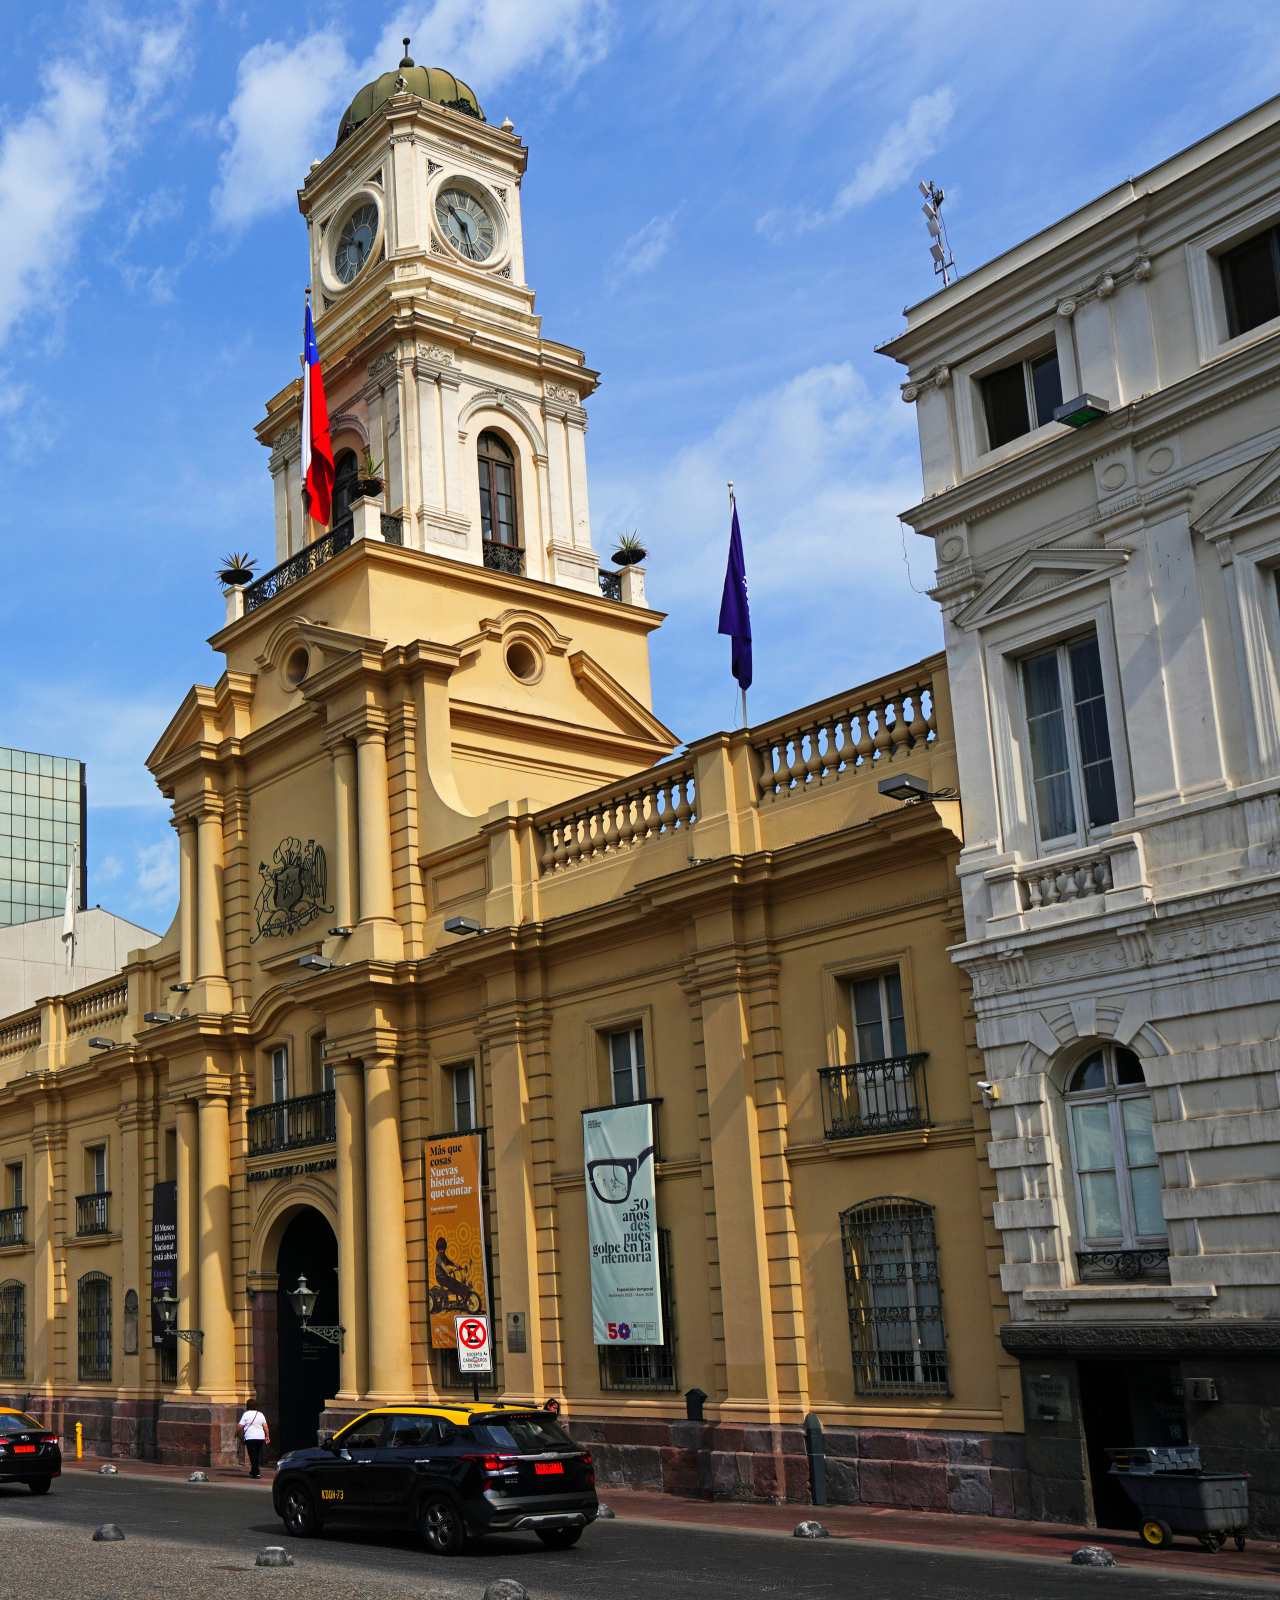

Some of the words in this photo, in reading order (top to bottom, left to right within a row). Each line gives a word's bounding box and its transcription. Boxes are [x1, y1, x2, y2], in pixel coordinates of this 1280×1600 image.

[430, 1145, 446, 1156] Más
[448, 1144, 462, 1156] que
[430, 1157, 452, 1167] cosas
[430, 1166, 458, 1178] Nuevas
[430, 1174, 464, 1188] historias
[430, 1190, 445, 1200] que
[446, 1186, 472, 1196] contar
[630, 1198, 648, 1212] 50
[622, 1210, 650, 1222] años
[160, 1224, 175, 1232] Museo
[630, 1220, 650, 1232] des
[154, 1233, 176, 1242] Histórico
[154, 1243, 174, 1251] Nacional
[592, 1242, 620, 1257] golpe
[624, 1243, 637, 1252] en
[640, 1240, 651, 1252] la
[601, 1252, 652, 1264] memoria
